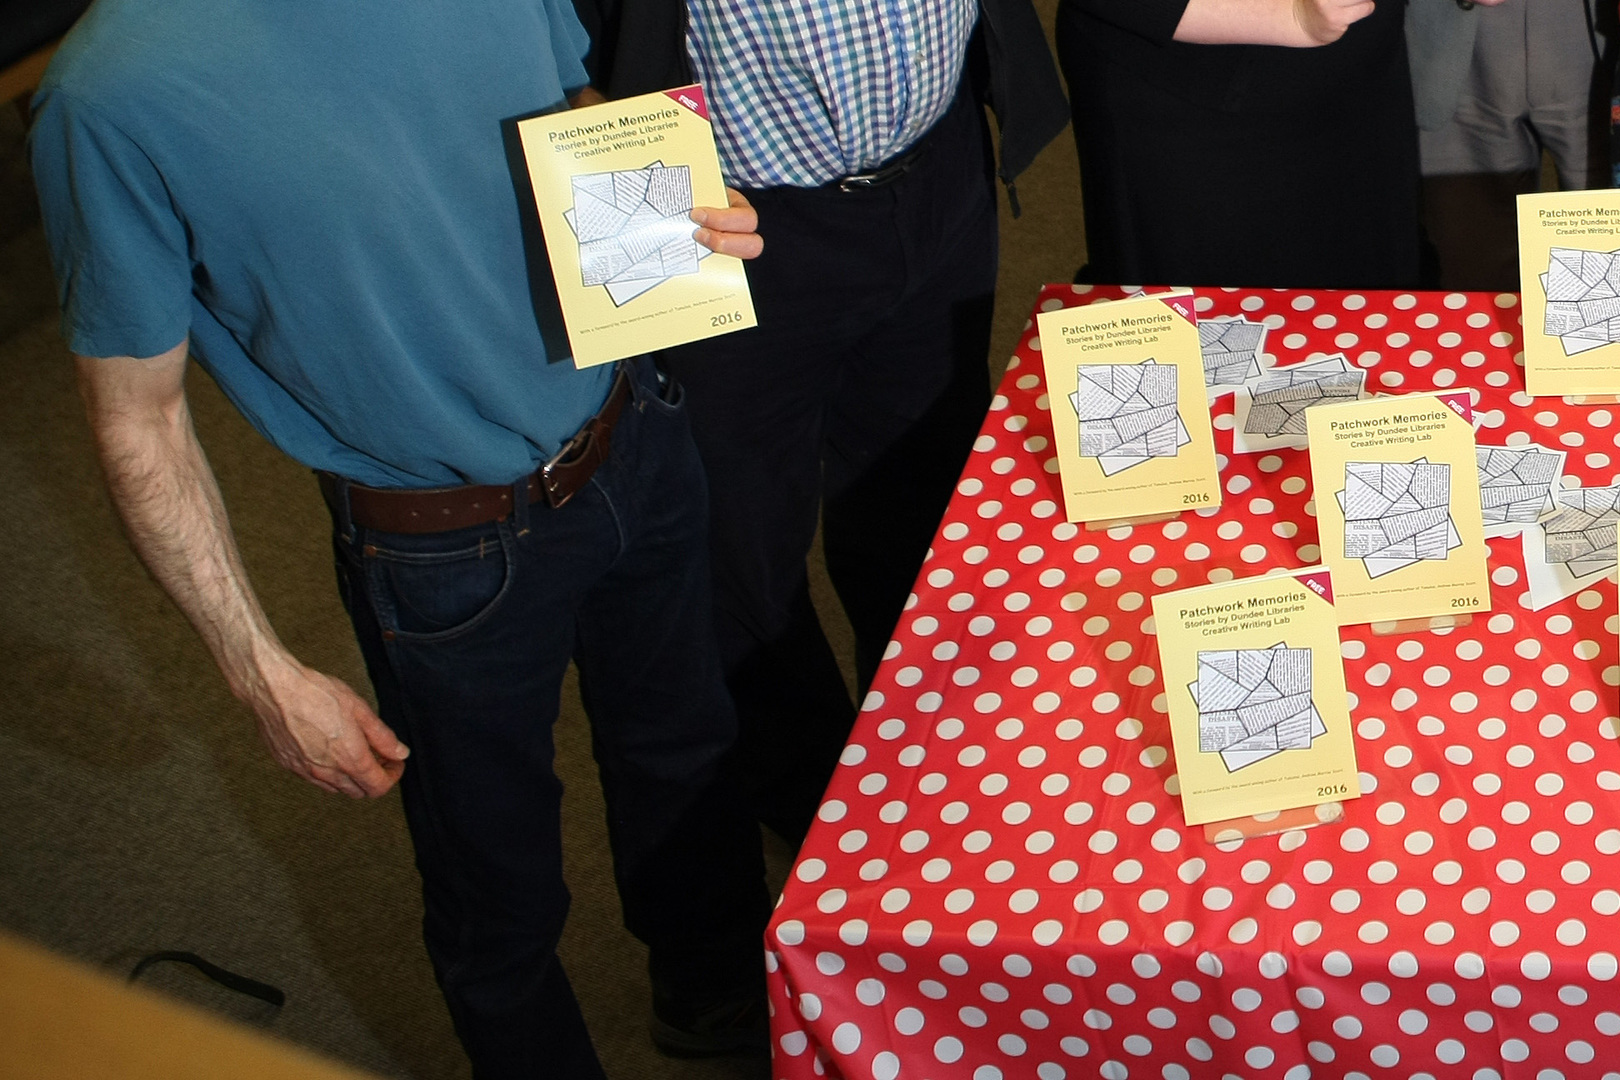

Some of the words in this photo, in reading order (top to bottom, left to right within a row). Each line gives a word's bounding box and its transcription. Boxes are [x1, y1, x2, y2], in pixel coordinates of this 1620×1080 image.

[548, 119, 616, 143] Patchwork
[618, 106, 679, 128] Memories
[554, 138, 587, 152] Stories
[589, 136, 601, 146] by
[602, 128, 637, 142] Dundee
[639, 119, 678, 135] Libraries
[573, 144, 611, 159] Creative
[613, 137, 646, 152] Writing
[647, 133, 664, 144] Lab
[1539, 208, 1592, 217] Patchwork
[1570, 219, 1578, 227] by
[1588, 227, 1613, 235] Writing
[710, 309, 742, 327] 2016
[1061, 319, 1118, 335] Patchwork
[1120, 312, 1172, 327] Memories
[1066, 334, 1093, 344] Stories
[1095, 333, 1104, 341] by
[1106, 329, 1135, 339] Dundee
[1137, 324, 1171, 334] Libraries
[1081, 341, 1112, 351] Creative
[1115, 337, 1142, 348] Writing
[1144, 335, 1158, 343] Lab
[1447, 399, 1465, 415] FREE
[1330, 416, 1390, 431] Patchwork
[1393, 410, 1447, 424] Memories
[1334, 430, 1363, 440] Stories
[1365, 430, 1375, 438] by
[1377, 426, 1408, 435] Dundee
[1410, 422, 1445, 432] Libraries
[1350, 438, 1383, 448] Creative
[1386, 435, 1414, 445] Writing
[1416, 433, 1431, 441] Lab
[1182, 492, 1209, 504] 2016
[1306, 579, 1325, 595] FREE
[1179, 600, 1244, 619] Patchwork
[1247, 590, 1306, 608] Memories
[1451, 596, 1479, 608] 2016
[1184, 617, 1215, 628] Stories
[1217, 615, 1228, 625] by
[1230, 609, 1264, 621] Dundee
[1266, 603, 1305, 616] Libraries
[1201, 623, 1238, 636] Creative
[1240, 618, 1272, 631] Writing
[1274, 615, 1290, 625] Lab
[1316, 783, 1347, 796] 2016
